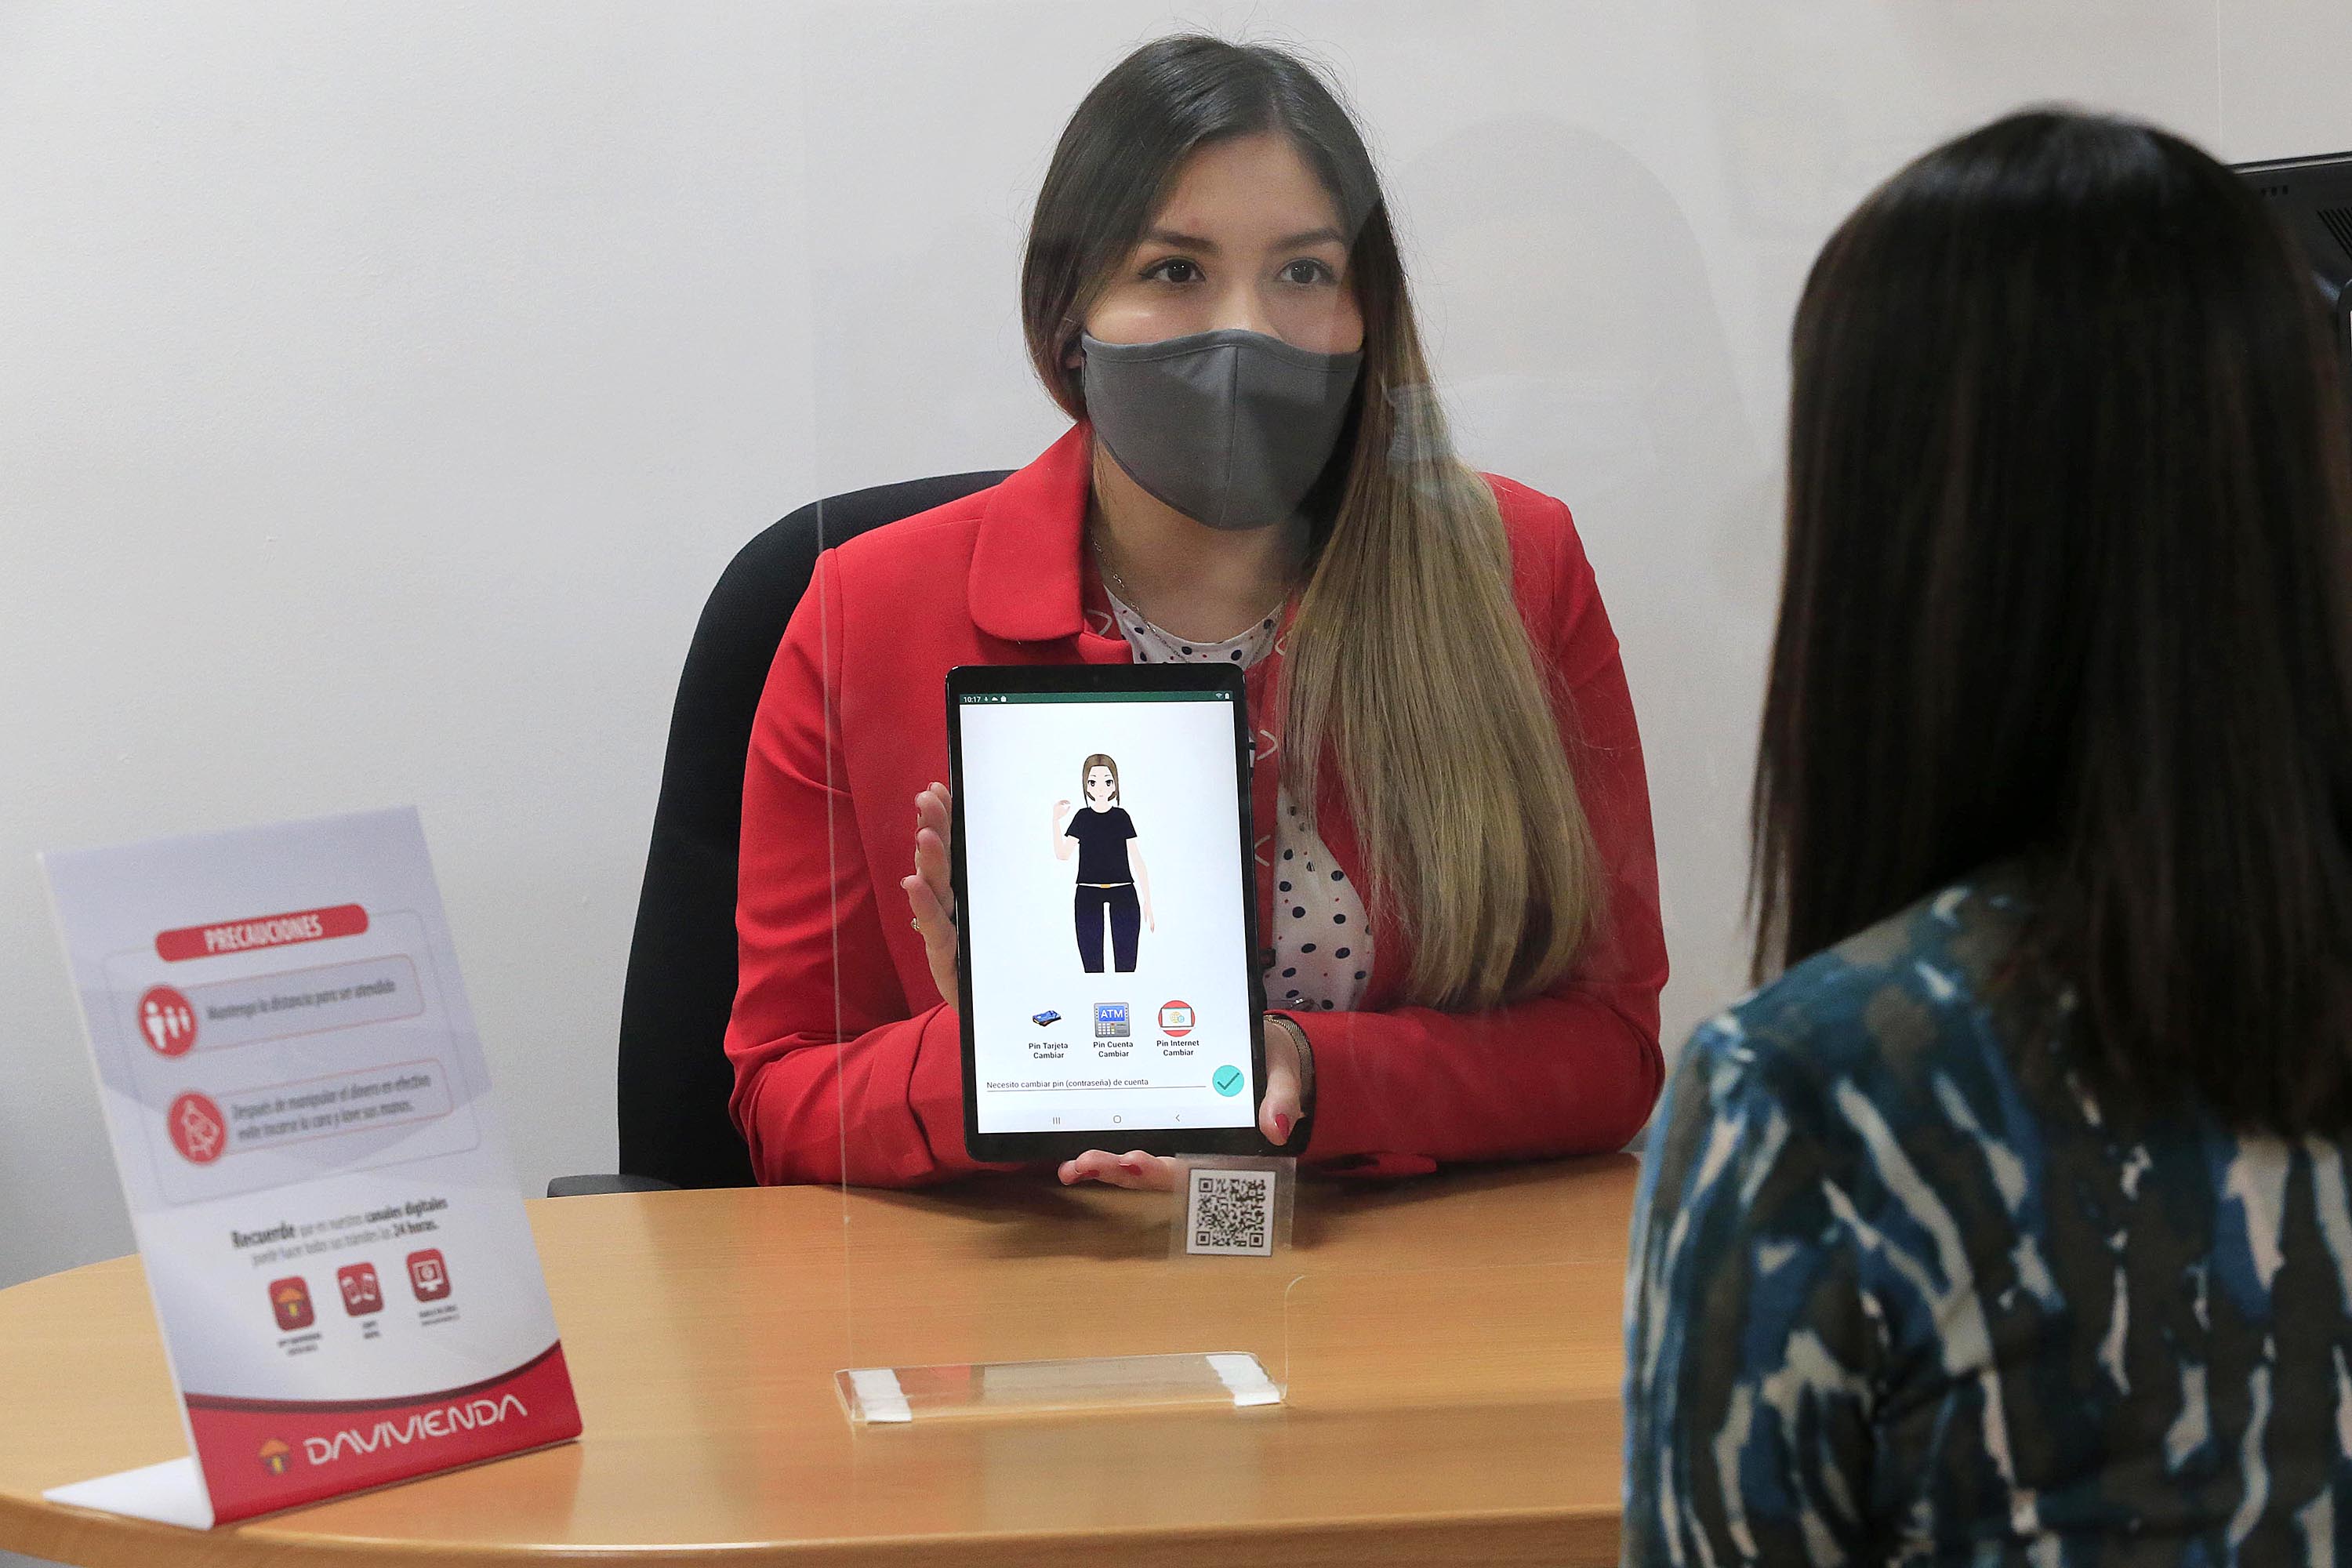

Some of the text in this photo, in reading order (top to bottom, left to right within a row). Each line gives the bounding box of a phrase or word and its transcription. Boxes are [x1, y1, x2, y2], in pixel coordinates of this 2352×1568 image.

[204, 913, 324, 953] PRECAUCIONES
[1100, 1008, 1124, 1019] ATM
[1043, 1042, 1069, 1051] Tarjeta
[1052, 1080, 1064, 1089] pin
[1065, 1079, 1112, 1088] (contraseña)
[230, 1221, 296, 1249] Recuerde
[405, 1196, 448, 1217] digitales
[394, 1222, 405, 1237] 24
[303, 1394, 528, 1465] DAVIVIENDA
